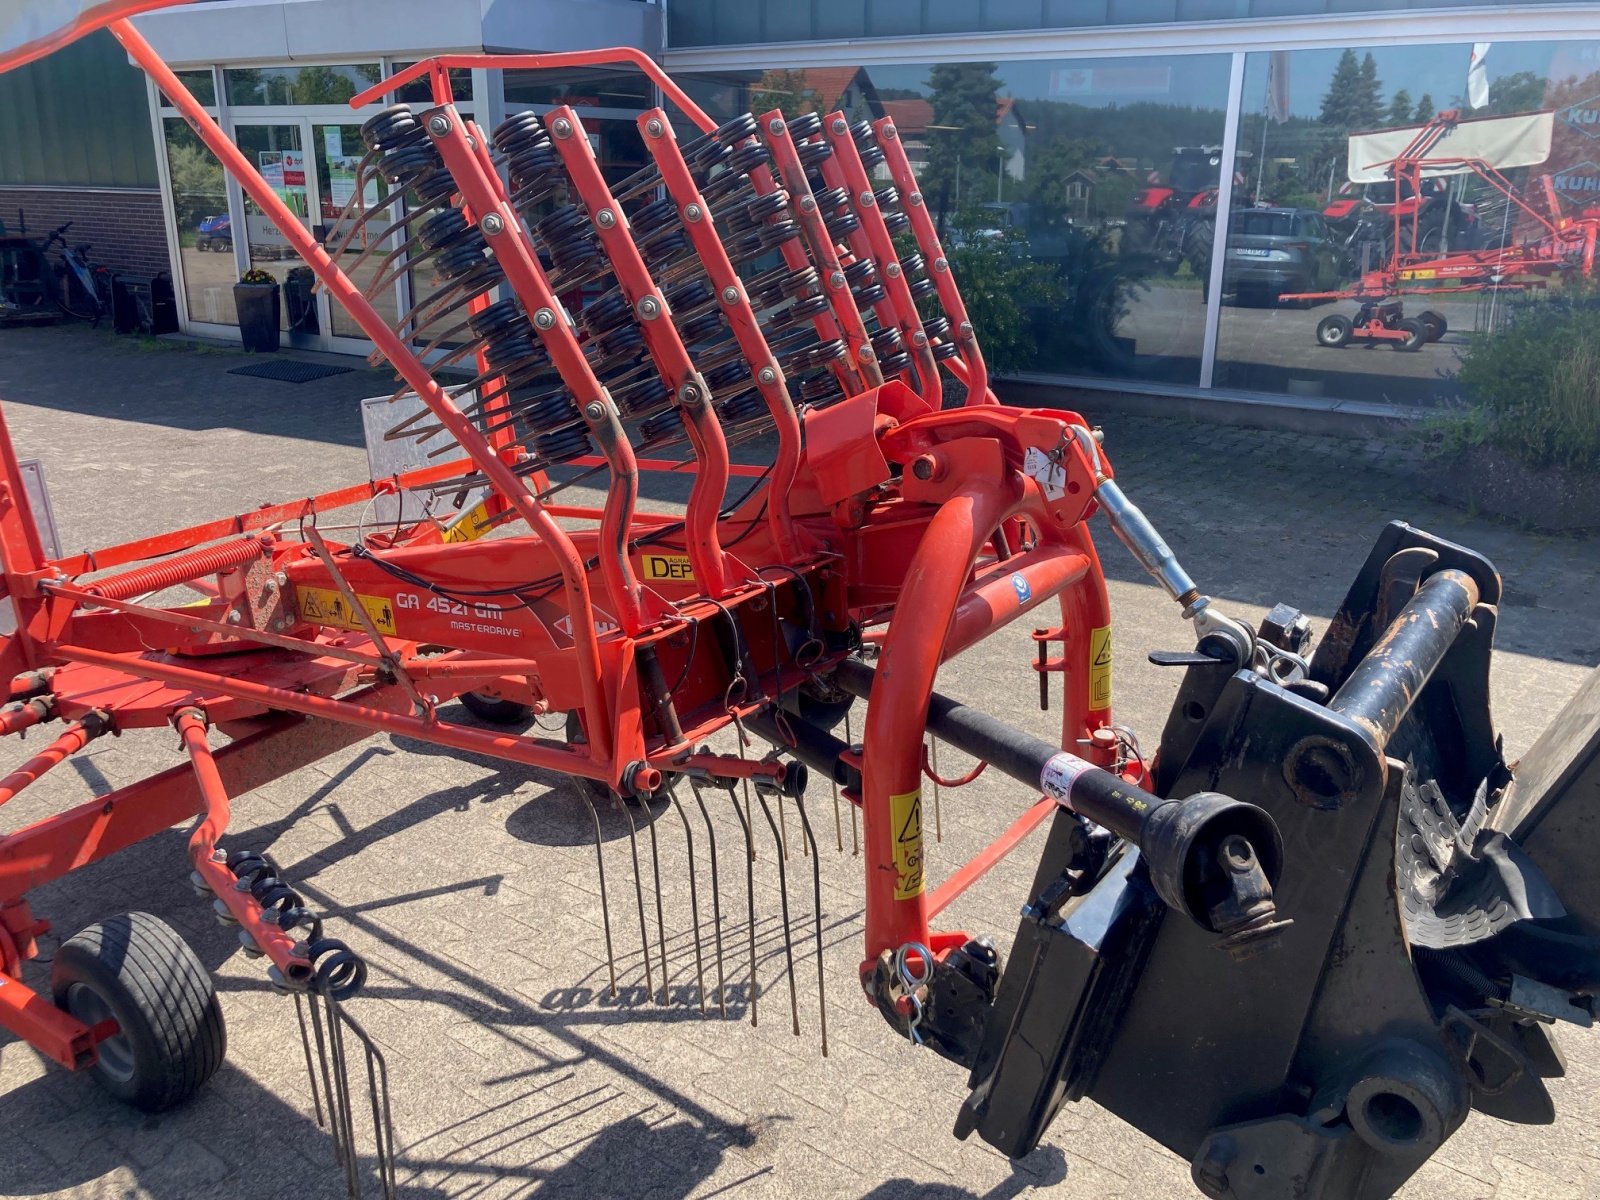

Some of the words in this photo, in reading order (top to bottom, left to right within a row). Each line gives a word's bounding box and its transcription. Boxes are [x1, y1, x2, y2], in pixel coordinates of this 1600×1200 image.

[1568, 109, 1600, 124] KU
[1554, 175, 1600, 191] KUH
[396, 593, 420, 610] GA
[426, 597, 468, 616] 4521
[474, 602, 503, 620] GM
[450, 620, 520, 637] MASTERDRIVE
